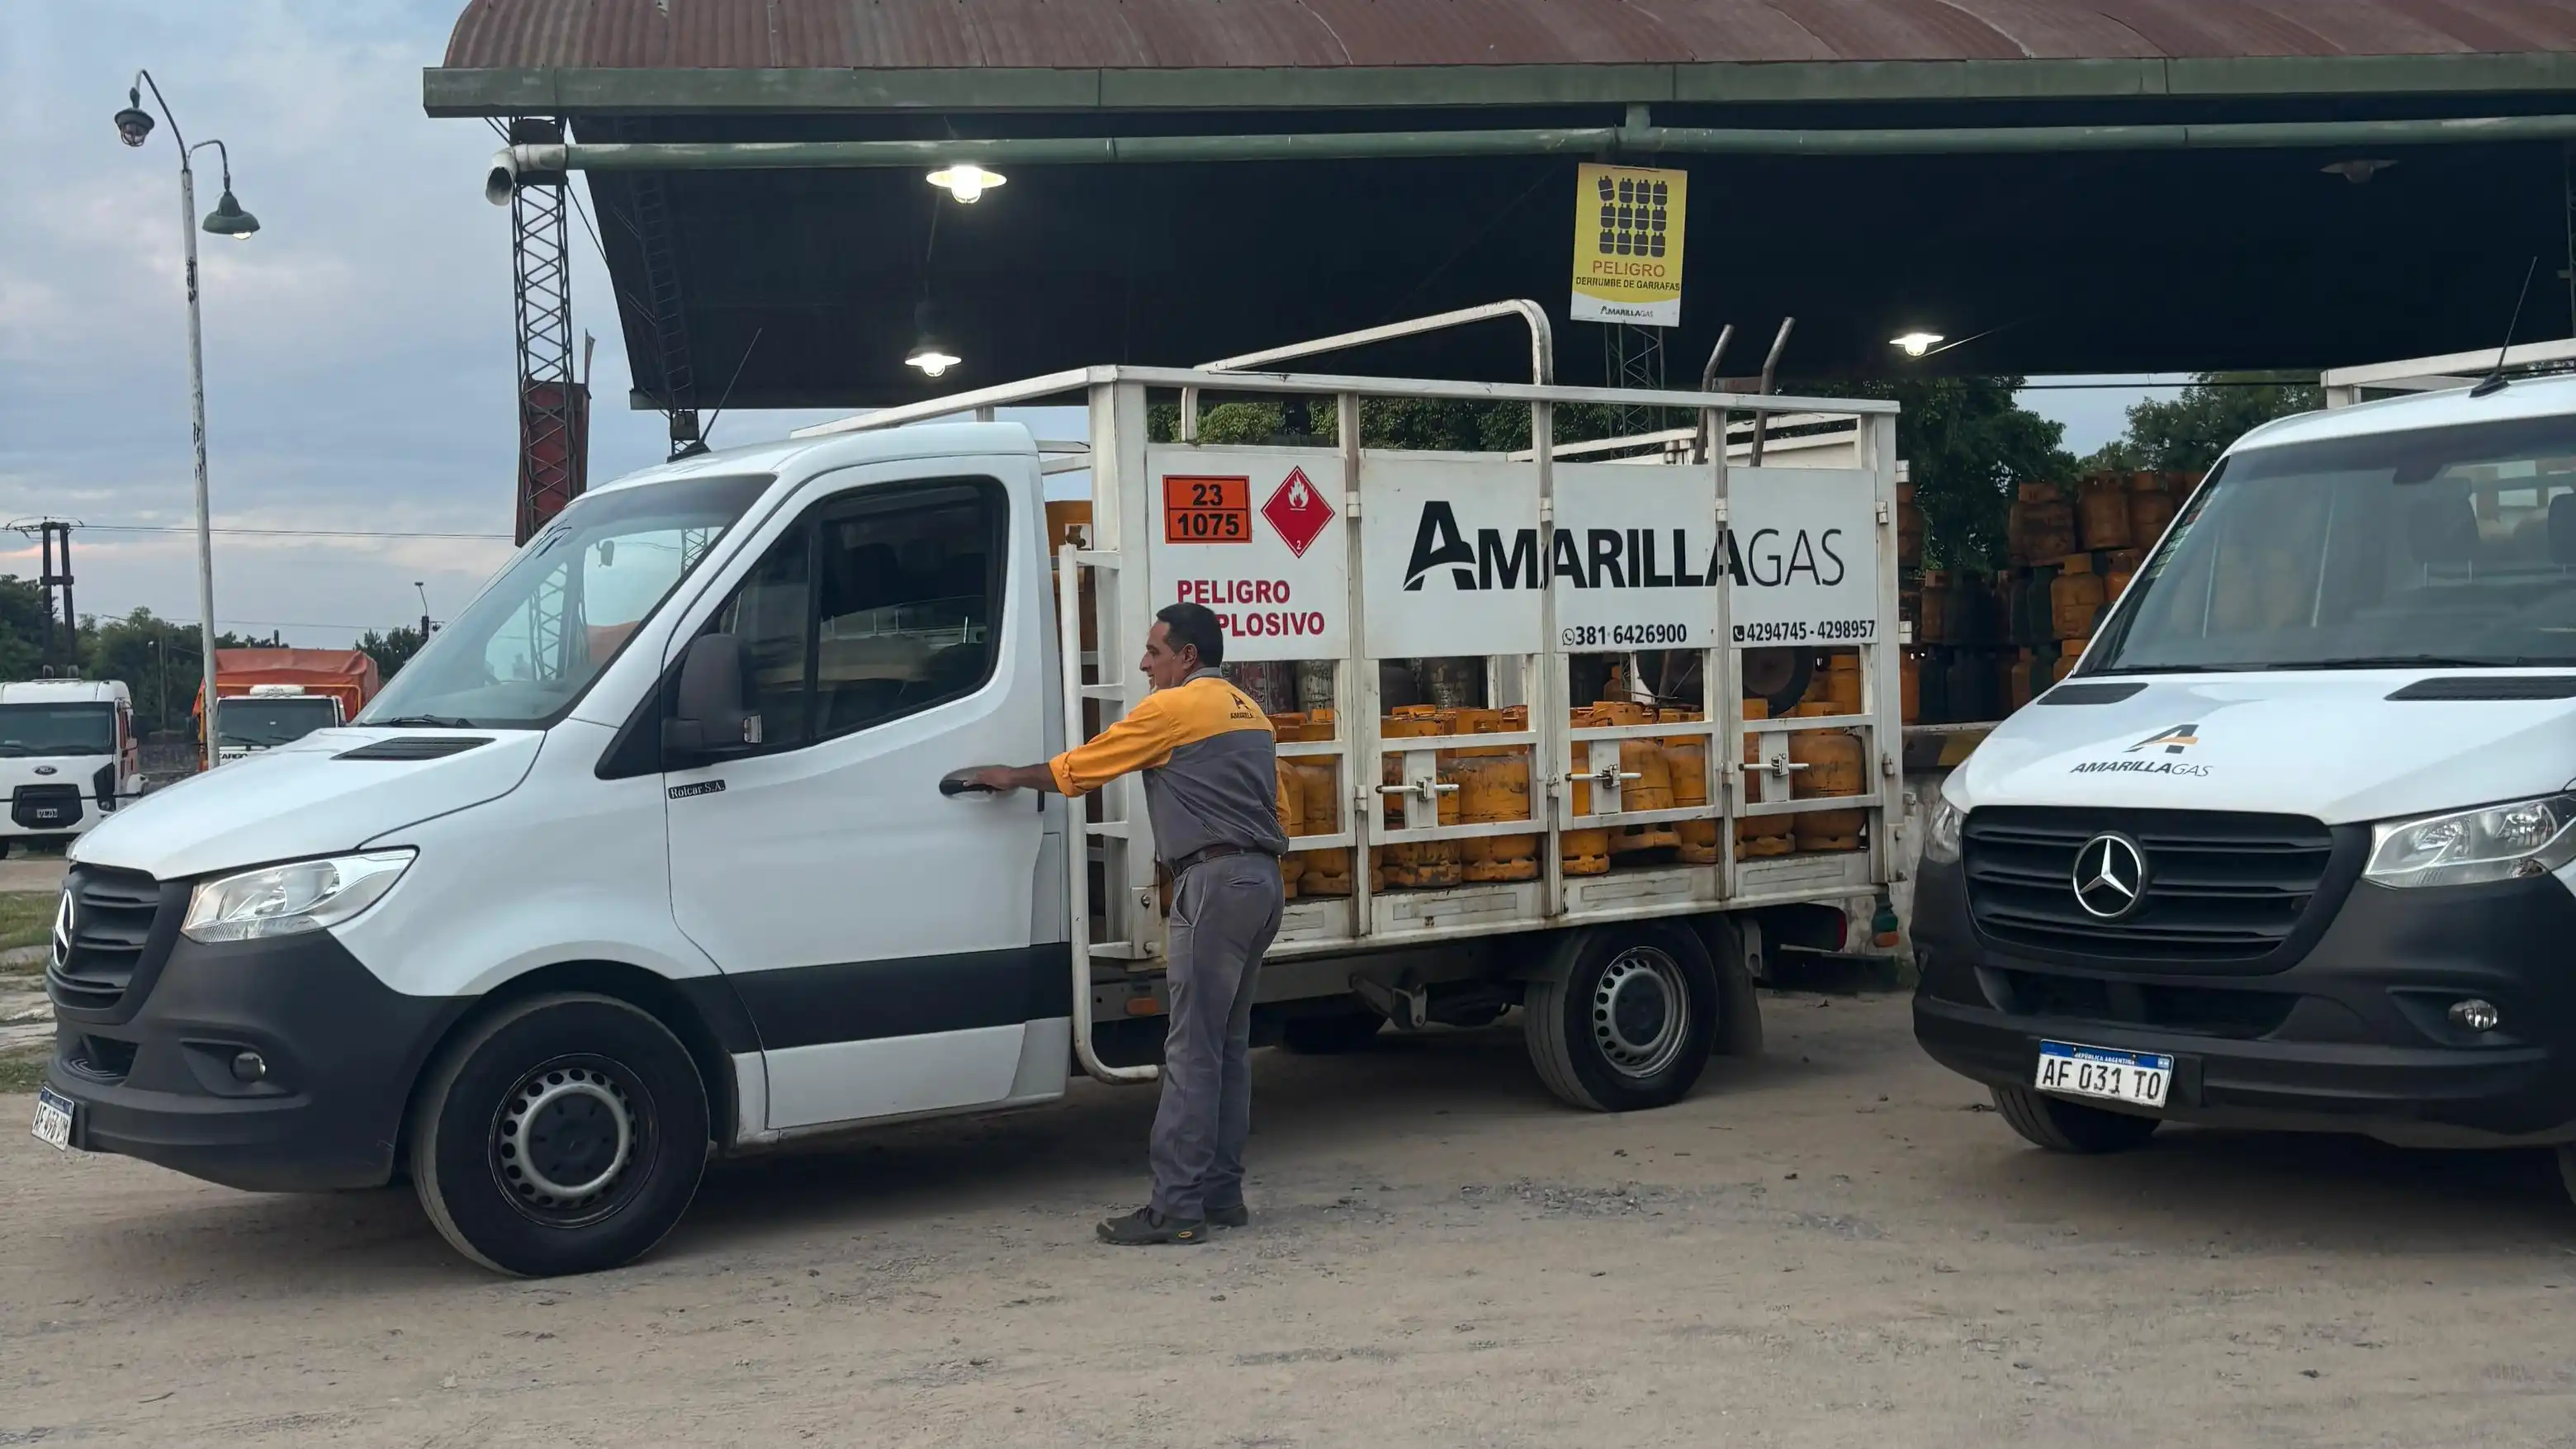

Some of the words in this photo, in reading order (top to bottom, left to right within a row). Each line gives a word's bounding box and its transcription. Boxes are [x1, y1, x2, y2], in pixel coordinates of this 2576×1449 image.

[1593, 260, 1665, 277] PELIGRO
[1575, 277, 1622, 288] DERRUMBE
[1623, 279, 1635, 288] DE
[1636, 281, 1680, 291] GARRAFAS
[1192, 484, 1224, 506] 23
[1177, 513, 1240, 536] 1075
[1296, 540, 1302, 551] 2
[1403, 500, 1844, 591] AMARILLAGAS
[1177, 580, 1290, 604] PELIGRO
[1215, 612, 1325, 637] PLOSIVO
[1575, 625, 1606, 646] 381
[1613, 623, 1687, 644] 6426900
[1747, 622, 1807, 642] 4294745
[1817, 620, 1875, 639] 4298957
[2070, 760, 2214, 777] AMARILLAGAS
[2042, 1058, 2072, 1087] AF
[2079, 1063, 2122, 1095] 031
